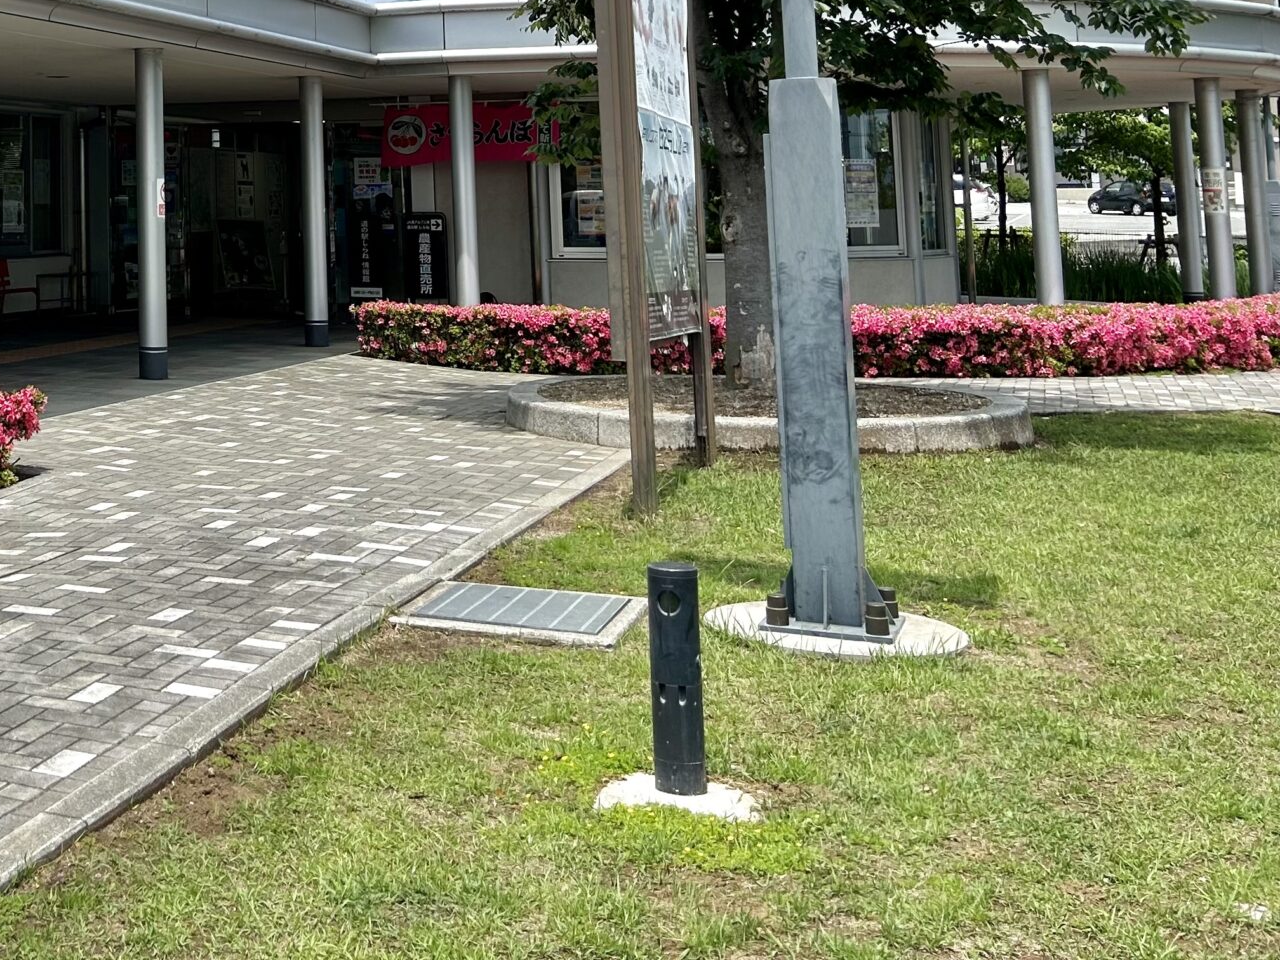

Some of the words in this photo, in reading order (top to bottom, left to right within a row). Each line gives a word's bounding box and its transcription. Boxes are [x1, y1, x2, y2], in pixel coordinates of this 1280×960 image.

[427, 118, 536, 147] さらんぼ
[360, 220, 370, 259] 道の駅しらね
[418, 232, 433, 295] 農産物直売所
